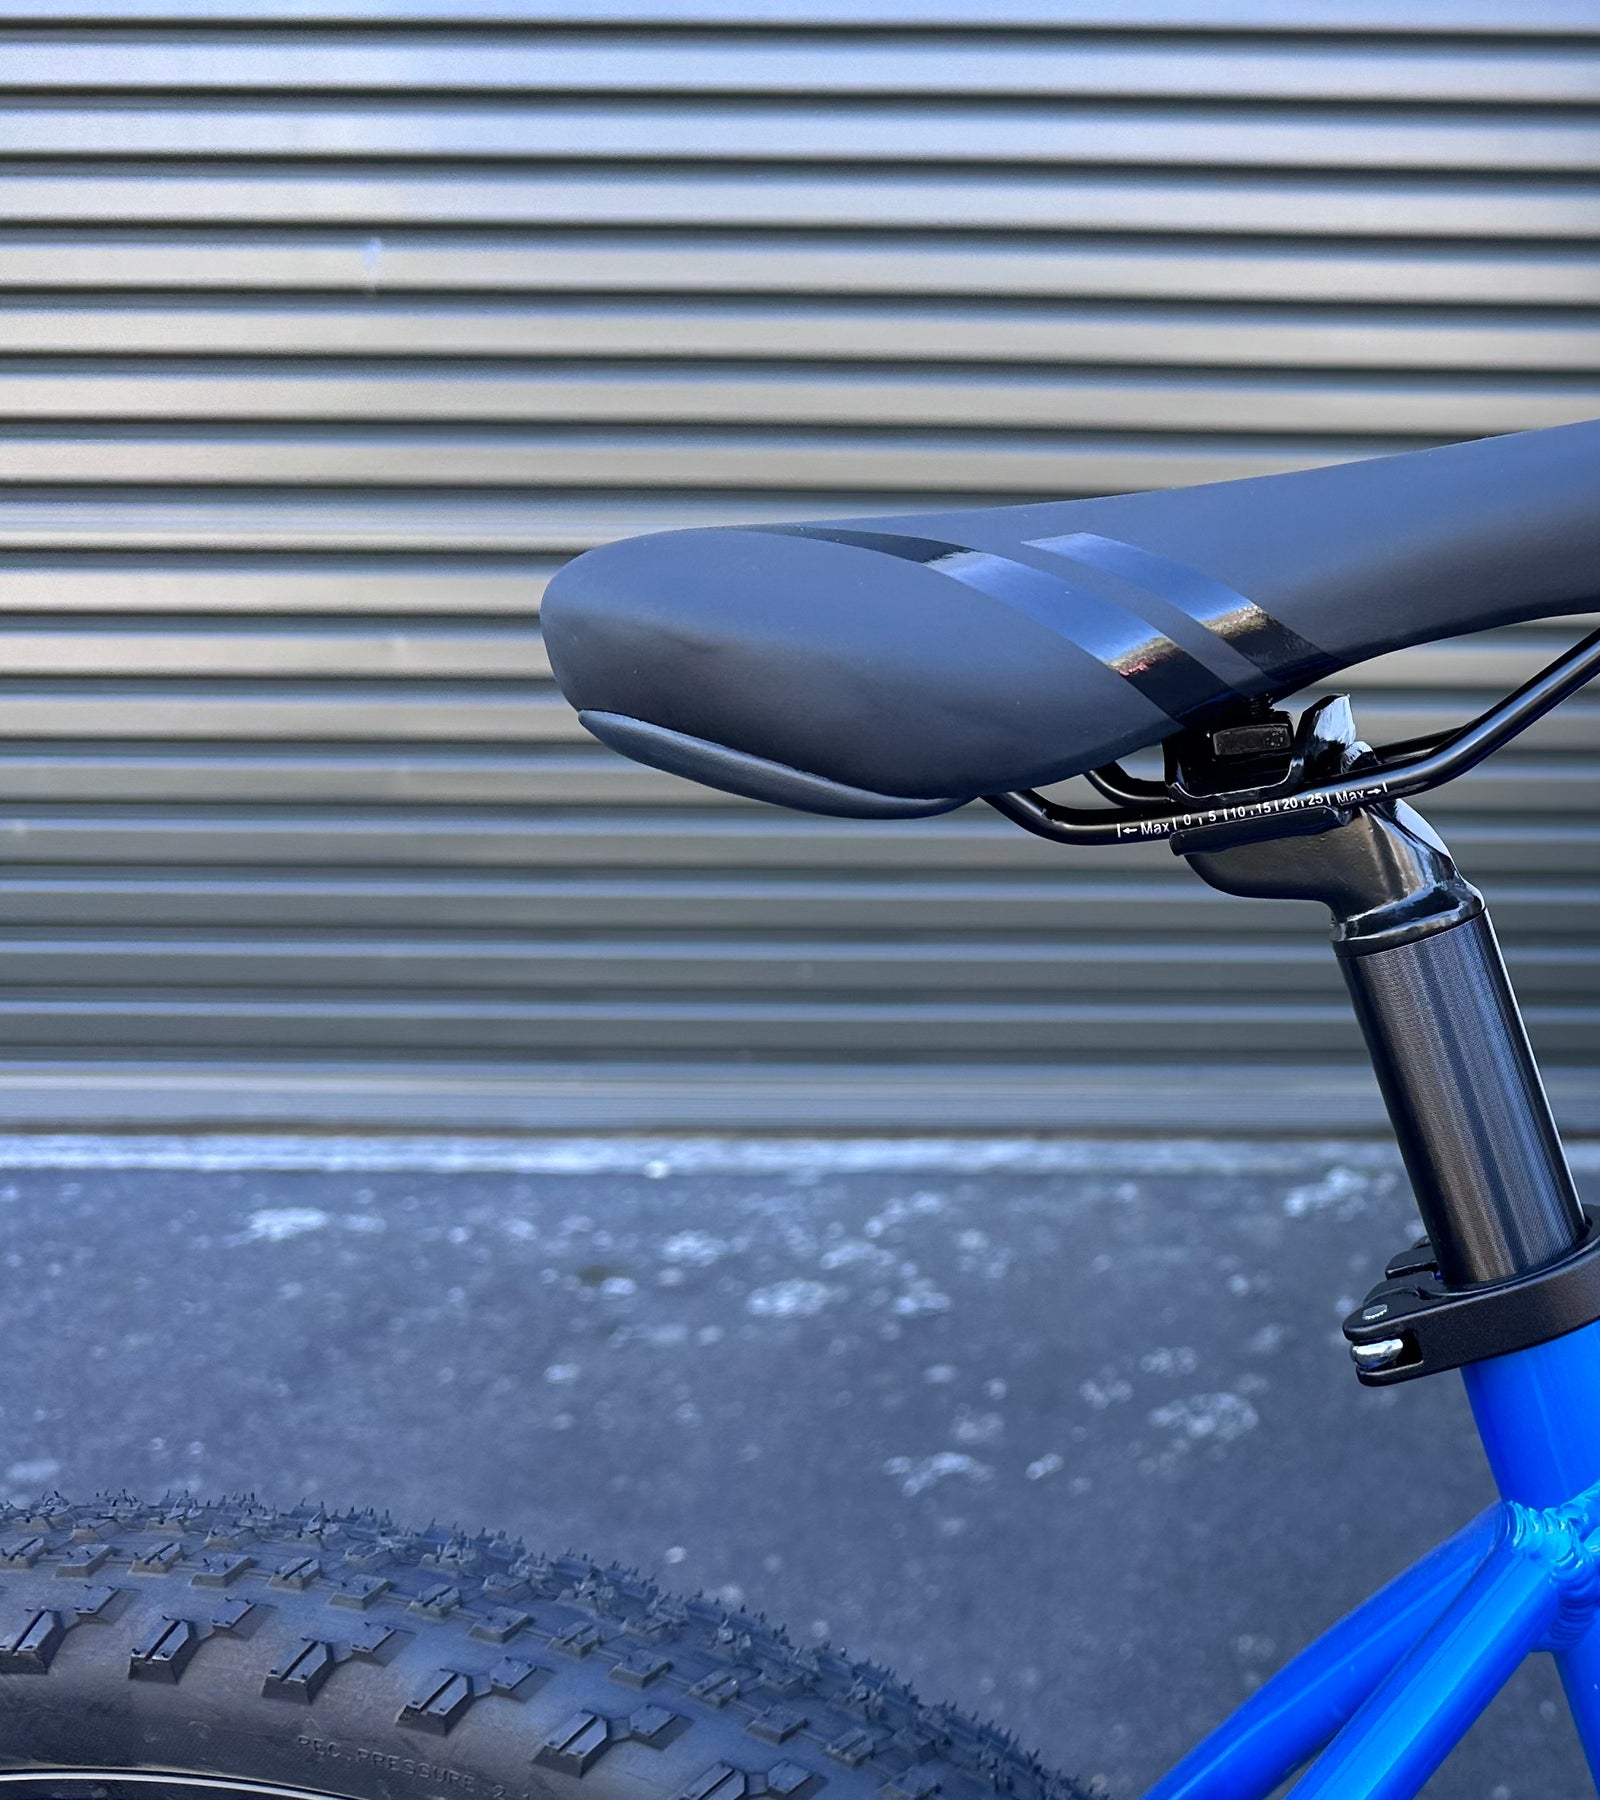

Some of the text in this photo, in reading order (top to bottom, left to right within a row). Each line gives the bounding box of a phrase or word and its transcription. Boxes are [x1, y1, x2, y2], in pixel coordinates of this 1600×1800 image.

[1140, 789, 1365, 836] Max 0 5 10 15 20 25 Max
[357, 1747, 477, 1793] PRESSURE
